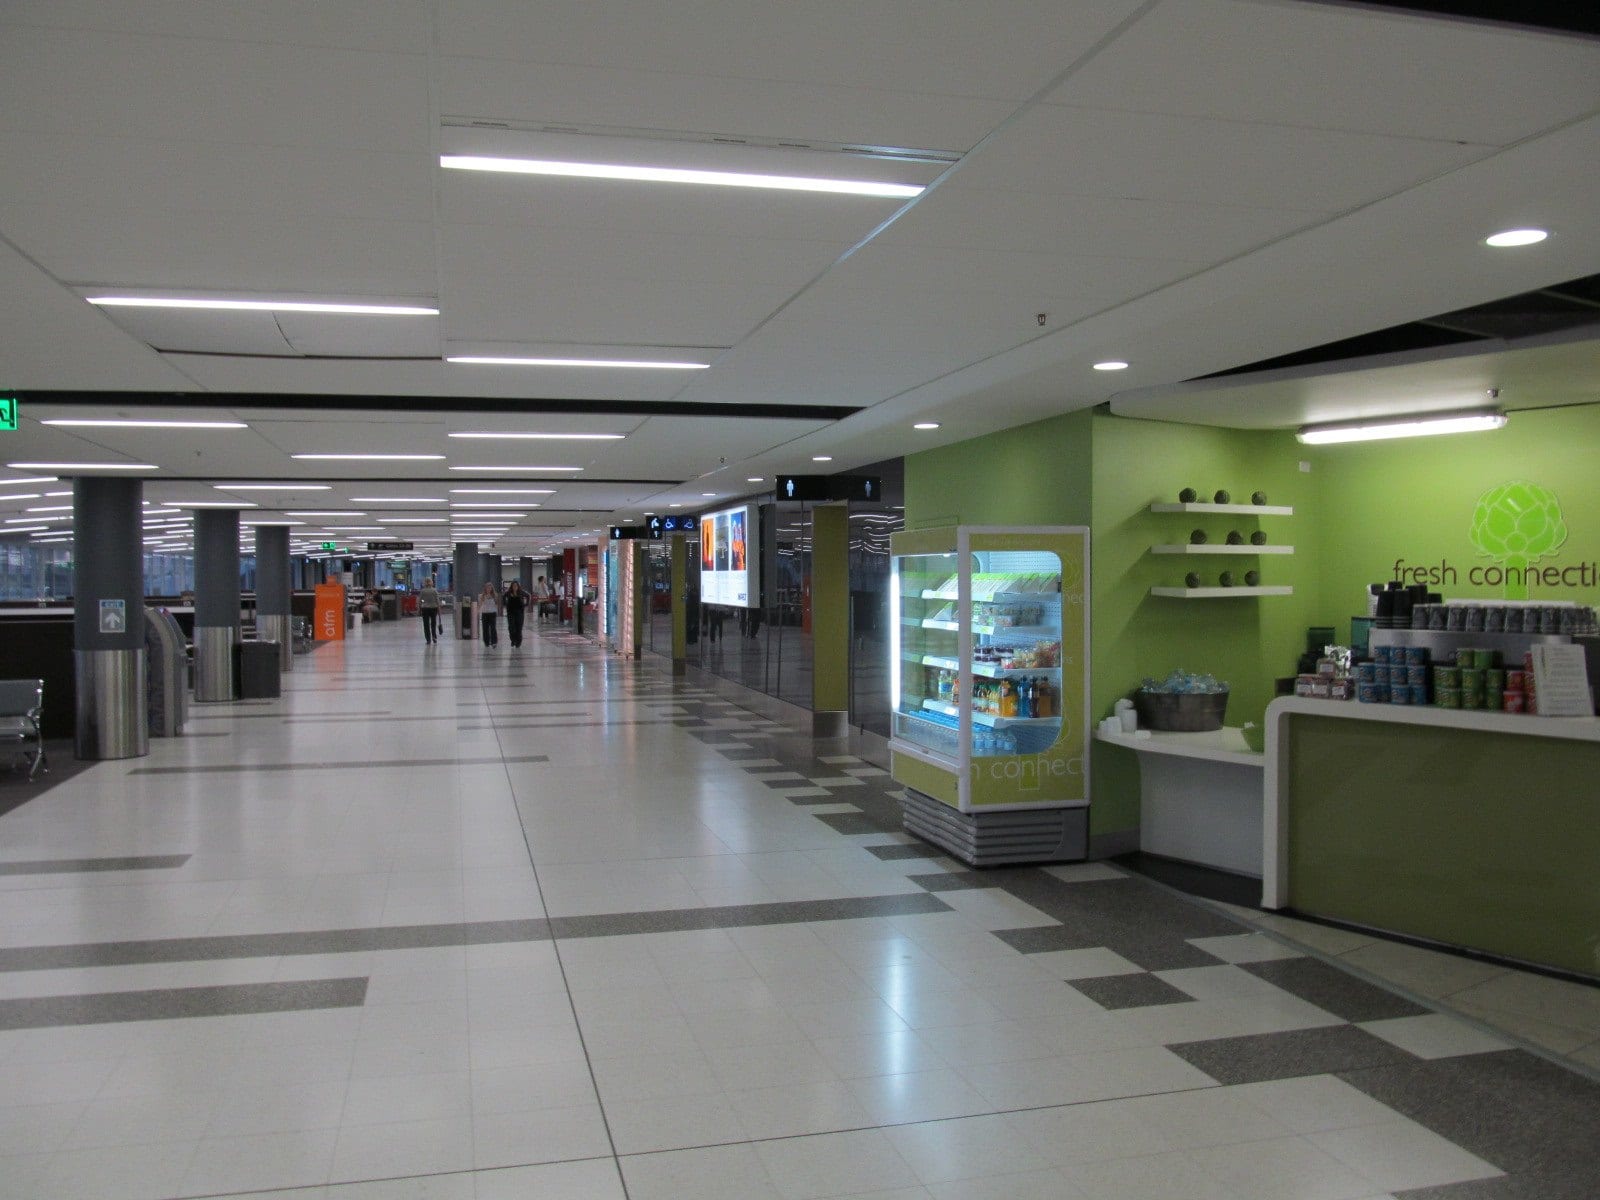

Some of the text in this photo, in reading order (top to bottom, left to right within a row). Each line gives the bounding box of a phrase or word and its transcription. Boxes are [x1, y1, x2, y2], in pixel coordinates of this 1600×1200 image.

[1393, 559, 1600, 587] fresh connecti
[323, 610, 336, 637] atm
